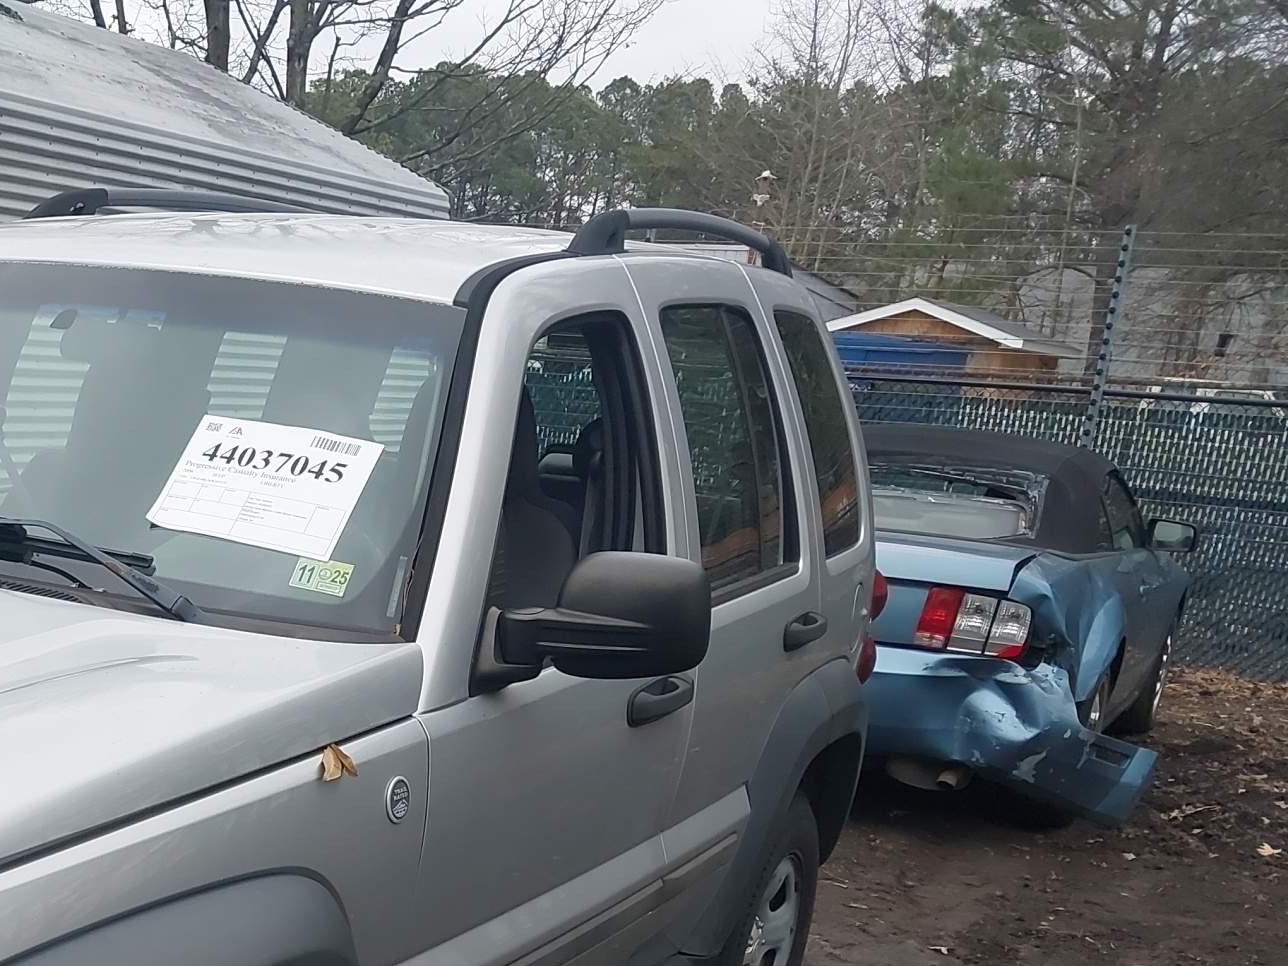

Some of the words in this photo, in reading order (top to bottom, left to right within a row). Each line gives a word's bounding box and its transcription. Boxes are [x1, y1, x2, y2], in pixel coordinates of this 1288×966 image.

[185, 460, 228, 472] Progressive
[227, 466, 259, 478] Casualty
[260, 471, 297, 483] Insurance
[202, 442, 349, 484] 44037045
[299, 564, 316, 584] 11
[330, 569, 350, 585] 25
